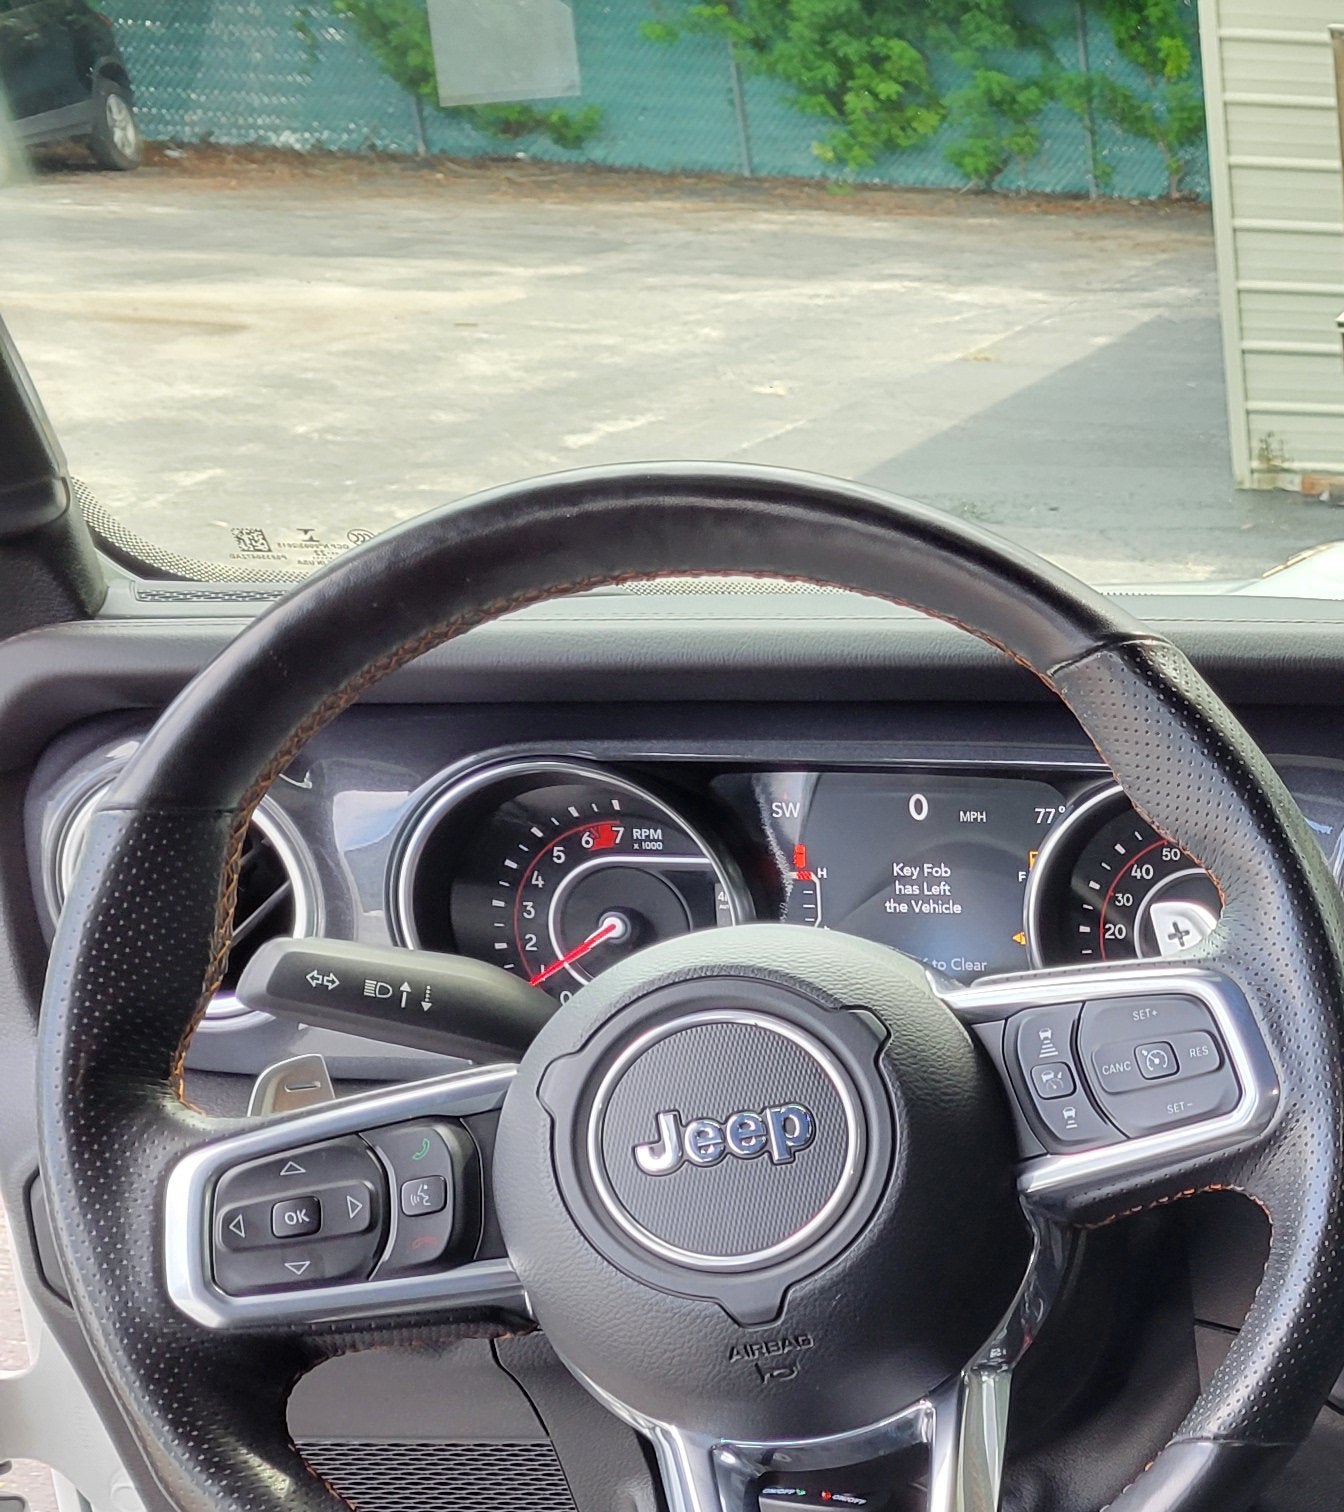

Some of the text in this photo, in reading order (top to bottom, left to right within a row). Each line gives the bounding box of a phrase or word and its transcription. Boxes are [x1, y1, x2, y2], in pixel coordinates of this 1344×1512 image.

[771, 801, 800, 818] SW
[908, 793, 928, 821] 0
[959, 810, 987, 823] MPH
[580, 831, 594, 849] 6
[611, 826, 625, 845] 7
[632, 827, 662, 841] RPM
[552, 846, 566, 863] 5
[639, 841, 663, 851] 1000
[1161, 846, 1181, 861] 50
[531, 871, 545, 888] 4
[816, 868, 828, 879] H
[892, 863, 951, 880] Key Fob
[1130, 864, 1154, 880] 40
[895, 880, 951, 896] has Left
[885, 899, 962, 914] the Vehicle
[1114, 893, 1133, 908] 30
[523, 901, 536, 919] 3
[1104, 924, 1127, 940] 20
[524, 934, 538, 951] 2
[950, 957, 988, 973] Clear
[1101, 1045, 1209, 1076] CANC RES
[634, 1102, 817, 1178] Jeep
[284, 1208, 310, 1226] OK
